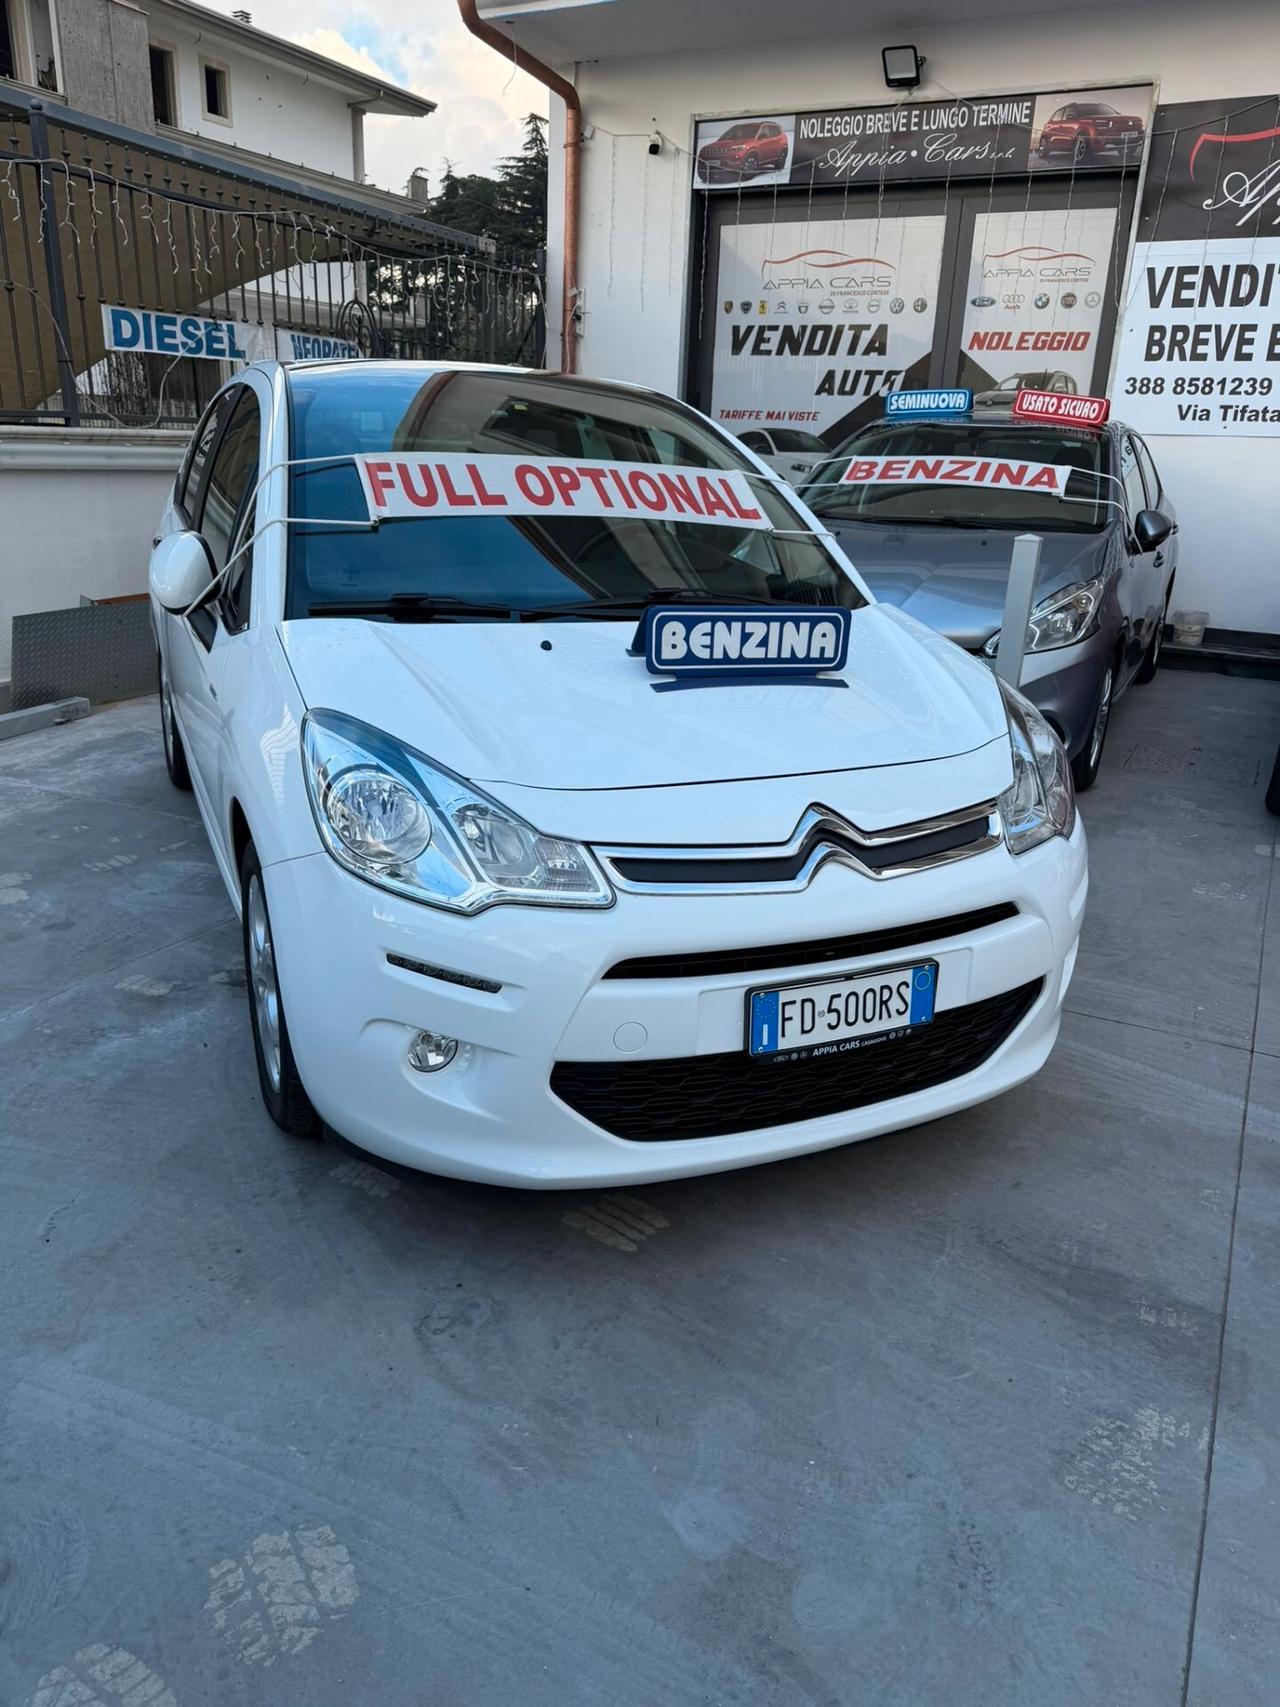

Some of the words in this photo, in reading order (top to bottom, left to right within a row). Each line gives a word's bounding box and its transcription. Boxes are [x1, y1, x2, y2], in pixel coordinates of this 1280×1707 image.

[800, 117, 864, 140] NOLEGGIO
[865, 111, 908, 135] BREVE
[910, 110, 920, 131] E
[922, 107, 969, 130] LUNGO
[972, 102, 1031, 127] TERMINE
[819, 140, 908, 177] Appia
[923, 133, 991, 163] Cars
[762, 278, 824, 290] APPIA
[829, 275, 892, 288] CARS
[983, 268, 1035, 278] APPIA
[1039, 266, 1091, 277] CARS
[1146, 263, 1280, 309] VENDI
[110, 308, 246, 359] DIESEL
[731, 324, 889, 357] VENDITA
[968, 331, 1091, 352] NOLEGGIO
[1144, 323, 1258, 362] BREVE
[814, 369, 906, 397] AUTO
[1124, 377, 1165, 396] 388
[1172, 377, 1273, 396] 8581239
[719, 409, 763, 420] TARIFFE
[765, 410, 787, 421] MAI
[788, 411, 820, 421] VISTE
[890, 392, 966, 410] SEMINUOVA
[1022, 395, 1057, 413] USATO
[1058, 398, 1100, 418] SICURO
[1177, 404, 1211, 422] Via
[1219, 404, 1280, 423] Tifata
[844, 458, 1059, 489] BENZINA
[365, 461, 508, 508] FULL
[514, 464, 762, 520] OPTIONAL
[660, 620, 837, 660] BENZINA
[812, 1045, 838, 1057] APPIA
[839, 1040, 861, 1052] CARS
